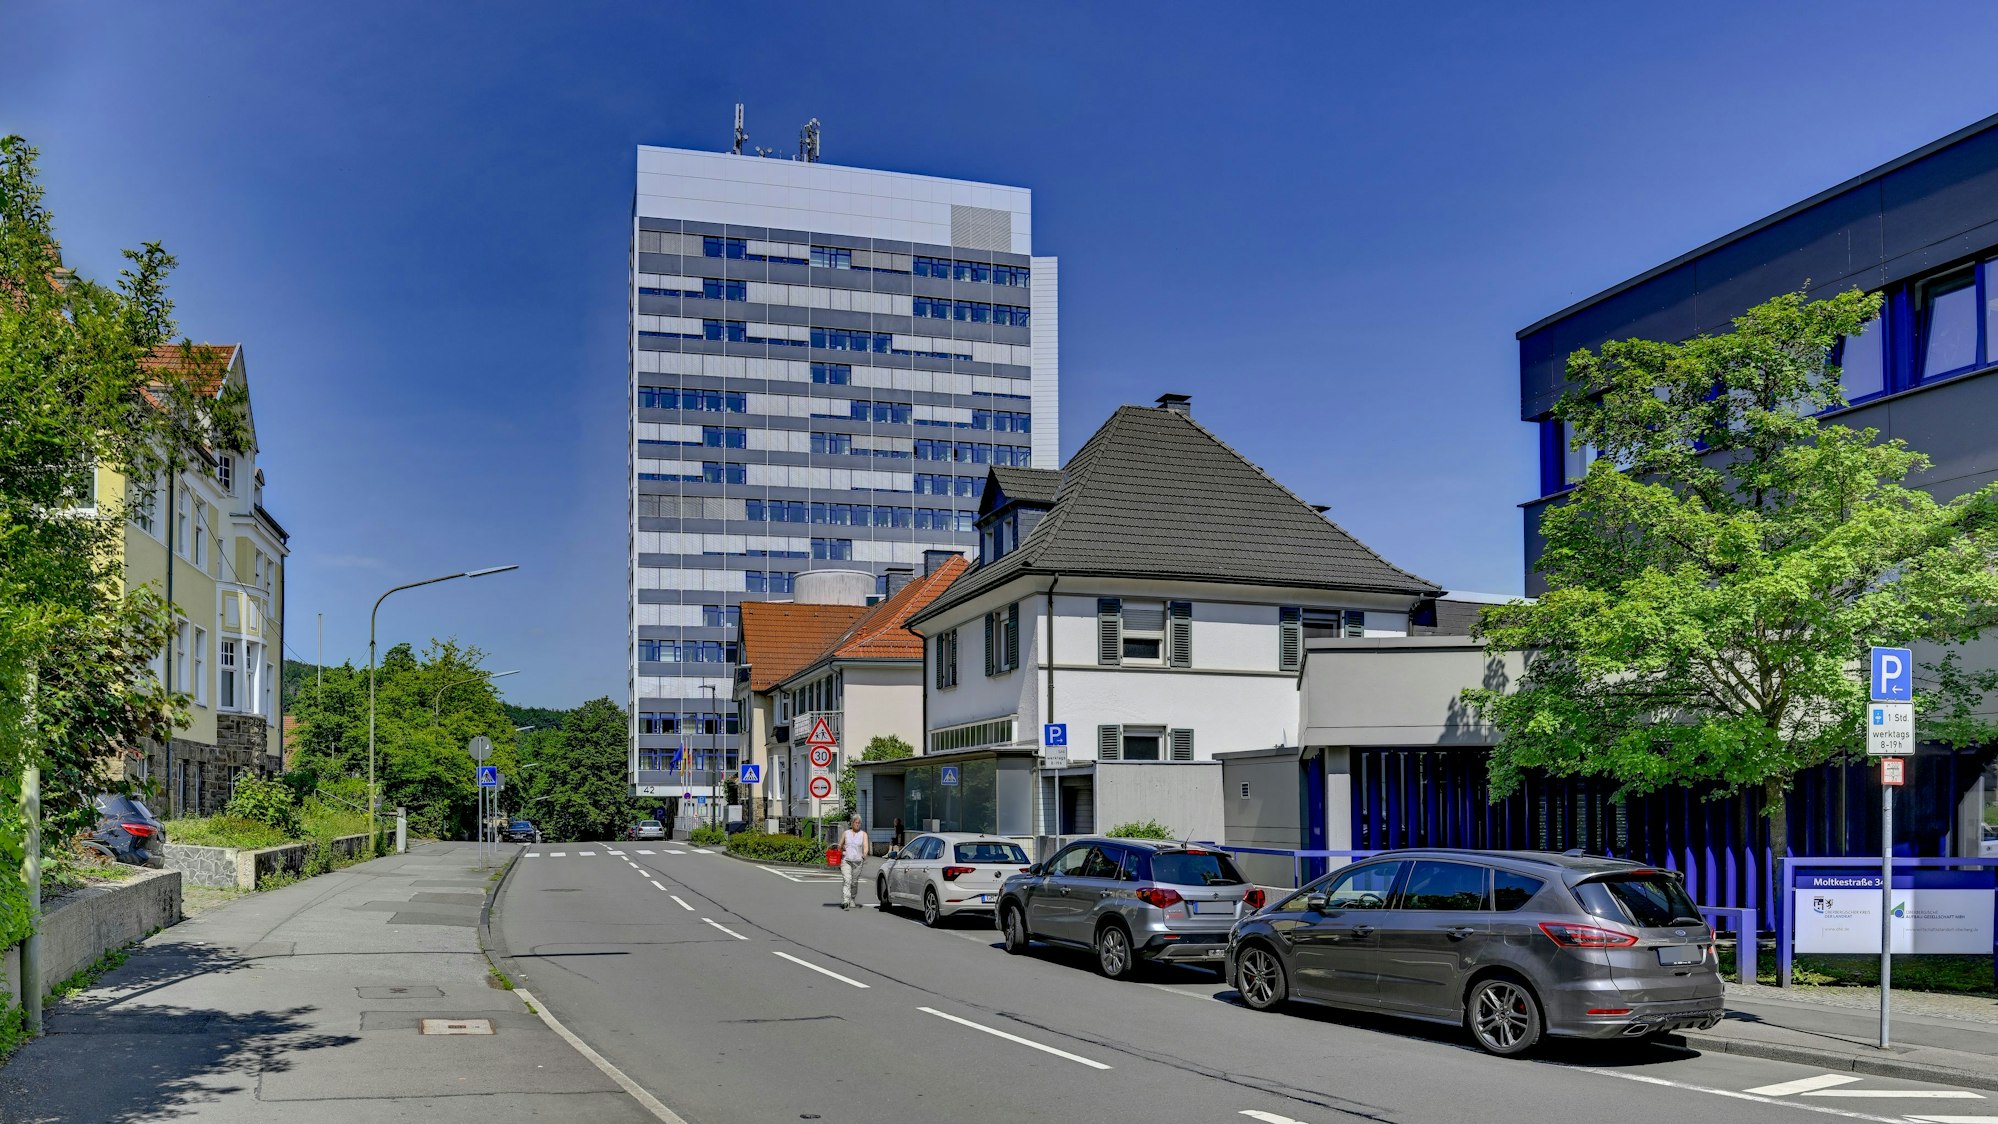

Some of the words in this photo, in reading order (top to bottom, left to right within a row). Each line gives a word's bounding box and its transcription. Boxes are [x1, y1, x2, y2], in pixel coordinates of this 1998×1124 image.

[1881, 655, 1902, 693] P
[1887, 713, 1891, 722] 1
[1895, 714, 1909, 722] Std.
[1050, 726, 1061, 743] P
[1873, 731, 1910, 740] werktags
[814, 751, 828, 761] 30
[643, 785, 655, 794] 42
[1814, 878, 1873, 886] Moltkestraße
